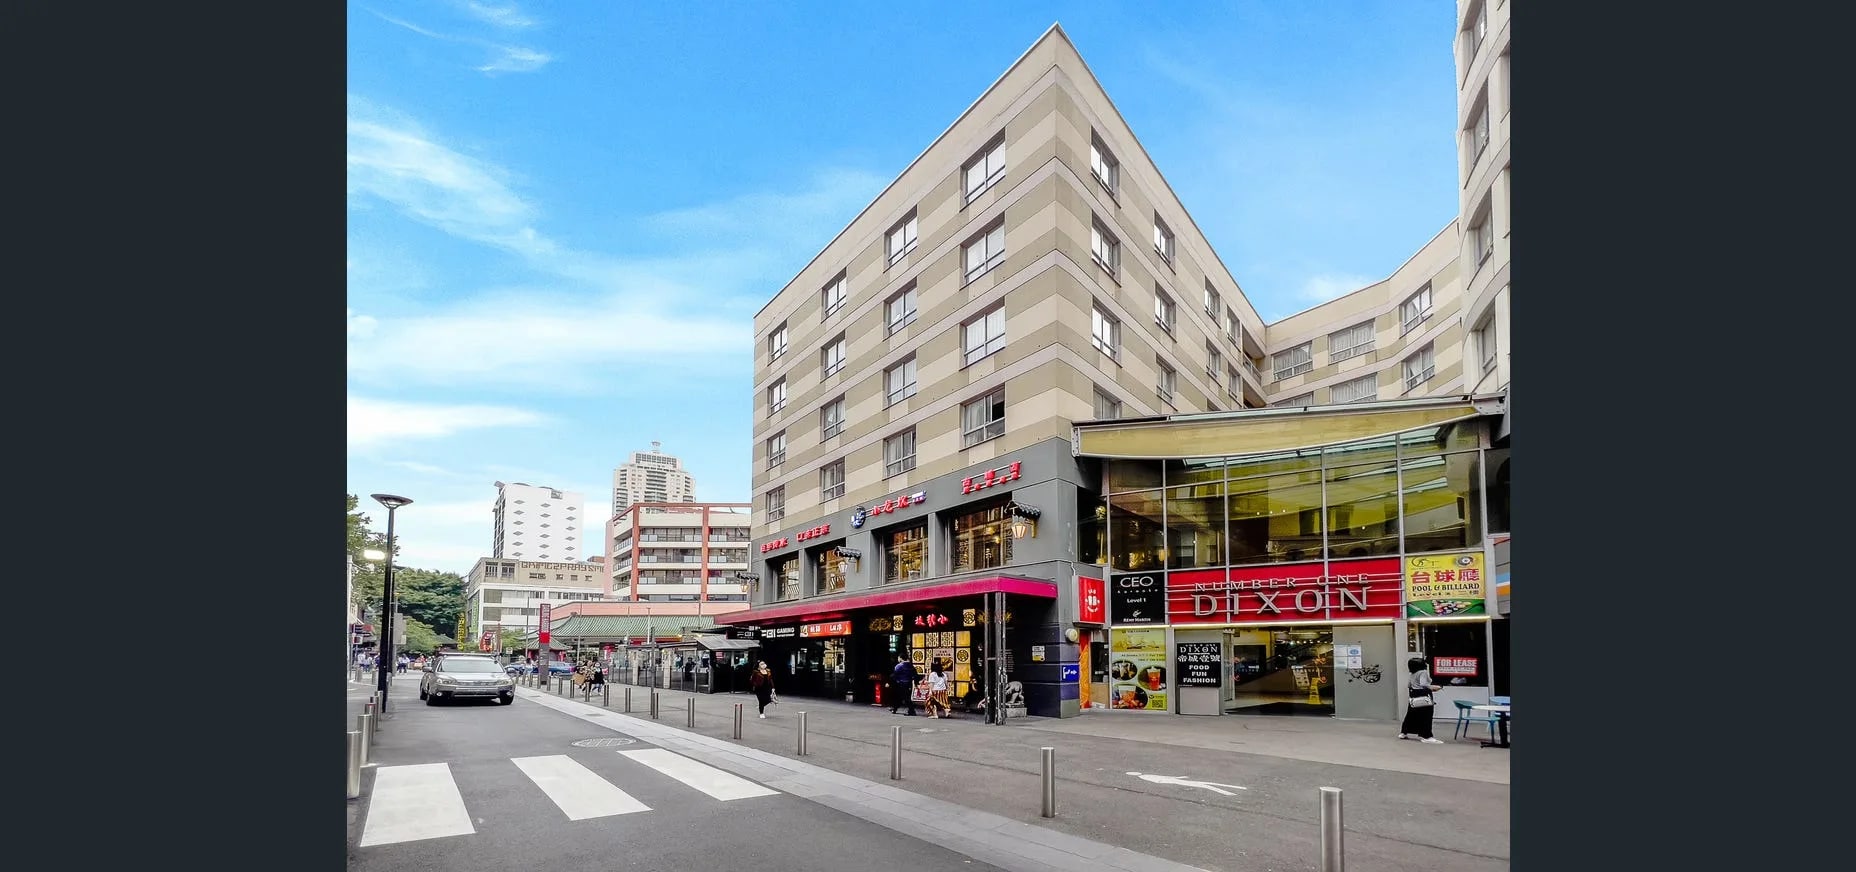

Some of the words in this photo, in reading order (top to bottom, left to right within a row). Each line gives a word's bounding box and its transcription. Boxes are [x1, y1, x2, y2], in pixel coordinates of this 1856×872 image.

[1120, 576, 1154, 588] CEO
[1195, 577, 1296, 592] NUMBER
[1317, 573, 1369, 586] ONE
[1411, 568, 1480, 584] 台球廳
[1442, 582, 1480, 591] BILLIARD
[1190, 586, 1373, 616] DIXON
[1436, 659, 1451, 667] FOR
[1453, 659, 1477, 667] LEASE
